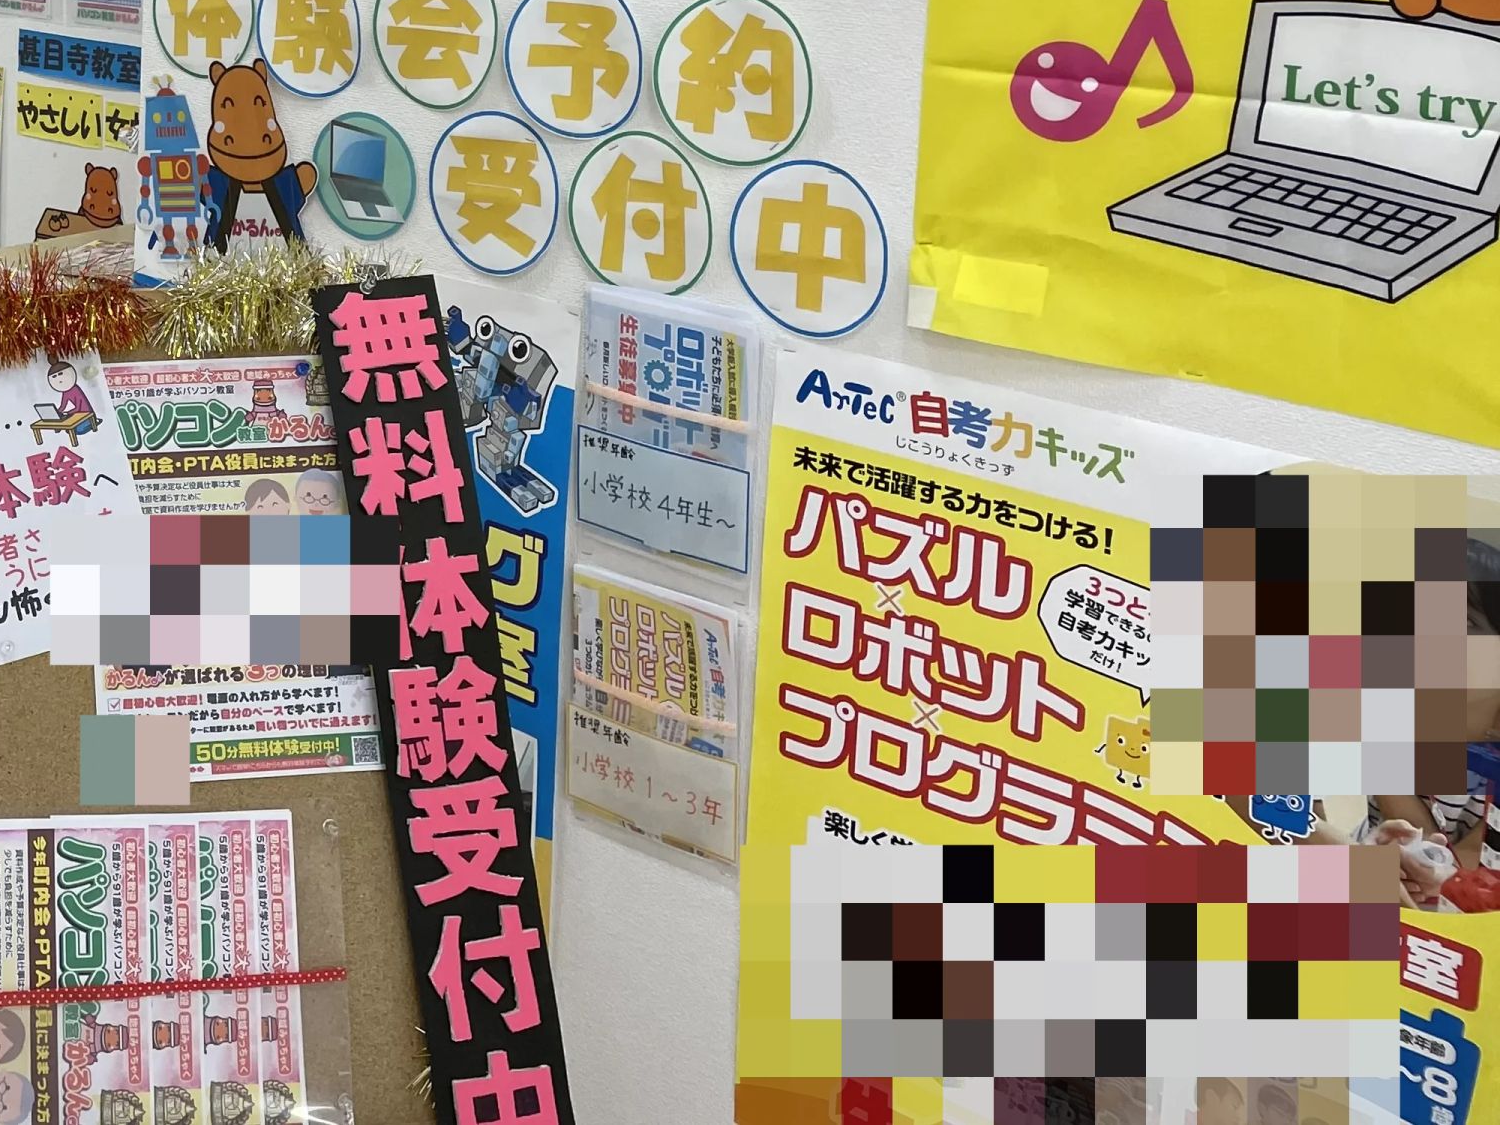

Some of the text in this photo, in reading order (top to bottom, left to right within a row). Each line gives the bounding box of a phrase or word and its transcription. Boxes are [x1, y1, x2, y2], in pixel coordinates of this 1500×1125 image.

[1282, 64, 1497, 138] Let's try
[446, 134, 867, 313] 受付中
[784, 486, 1033, 620] パズル
[782, 582, 1086, 742] ロボット
